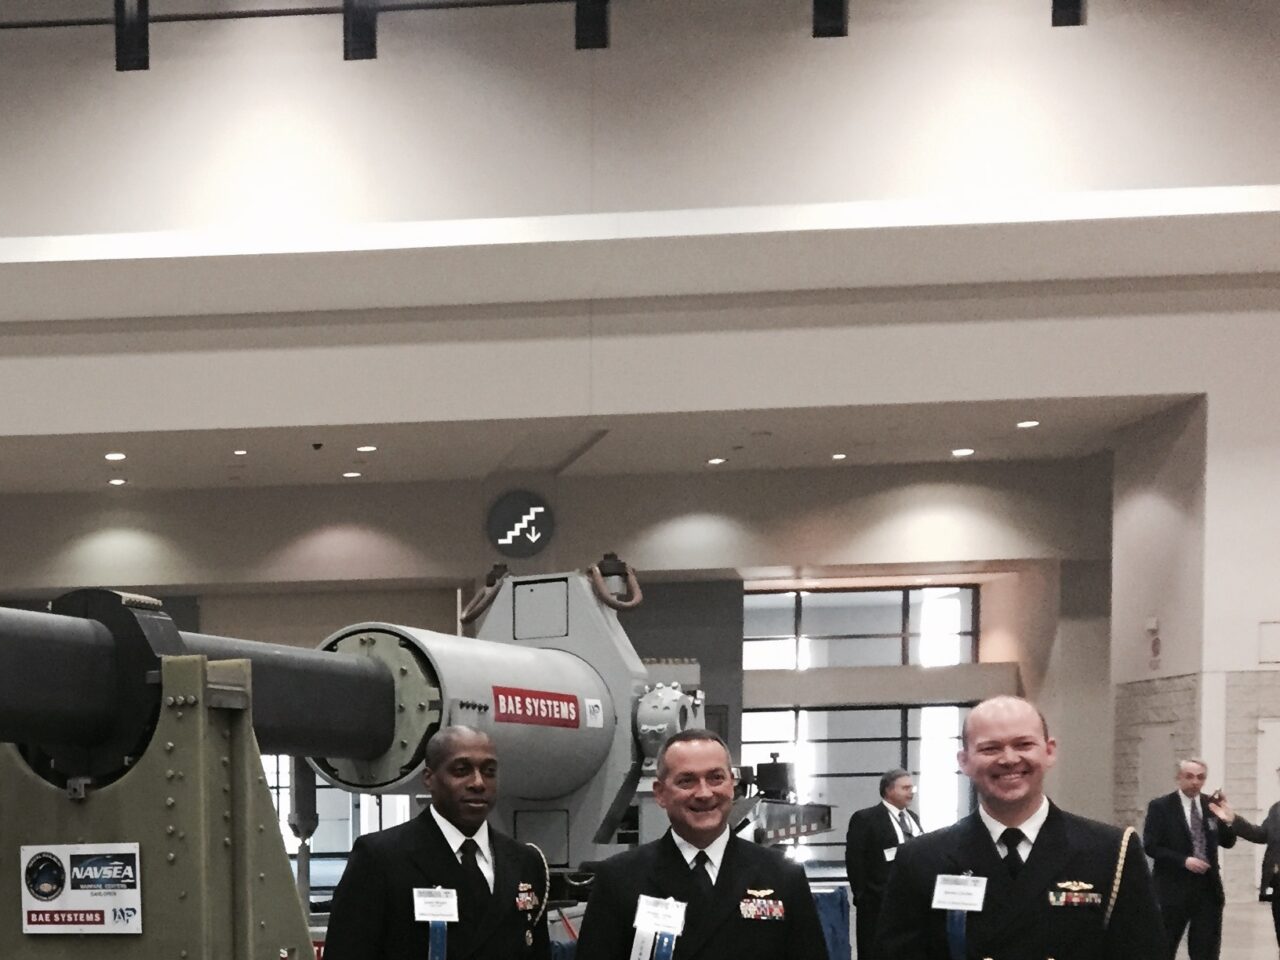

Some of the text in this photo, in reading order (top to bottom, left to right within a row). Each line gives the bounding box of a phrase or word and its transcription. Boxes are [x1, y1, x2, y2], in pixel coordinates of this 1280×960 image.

[498, 694, 523, 715] BAE
[525, 697, 576, 720] SYSTEMS
[71, 865, 134, 879] NAVSEA
[31, 913, 101, 922] BAE SYSTEMS
